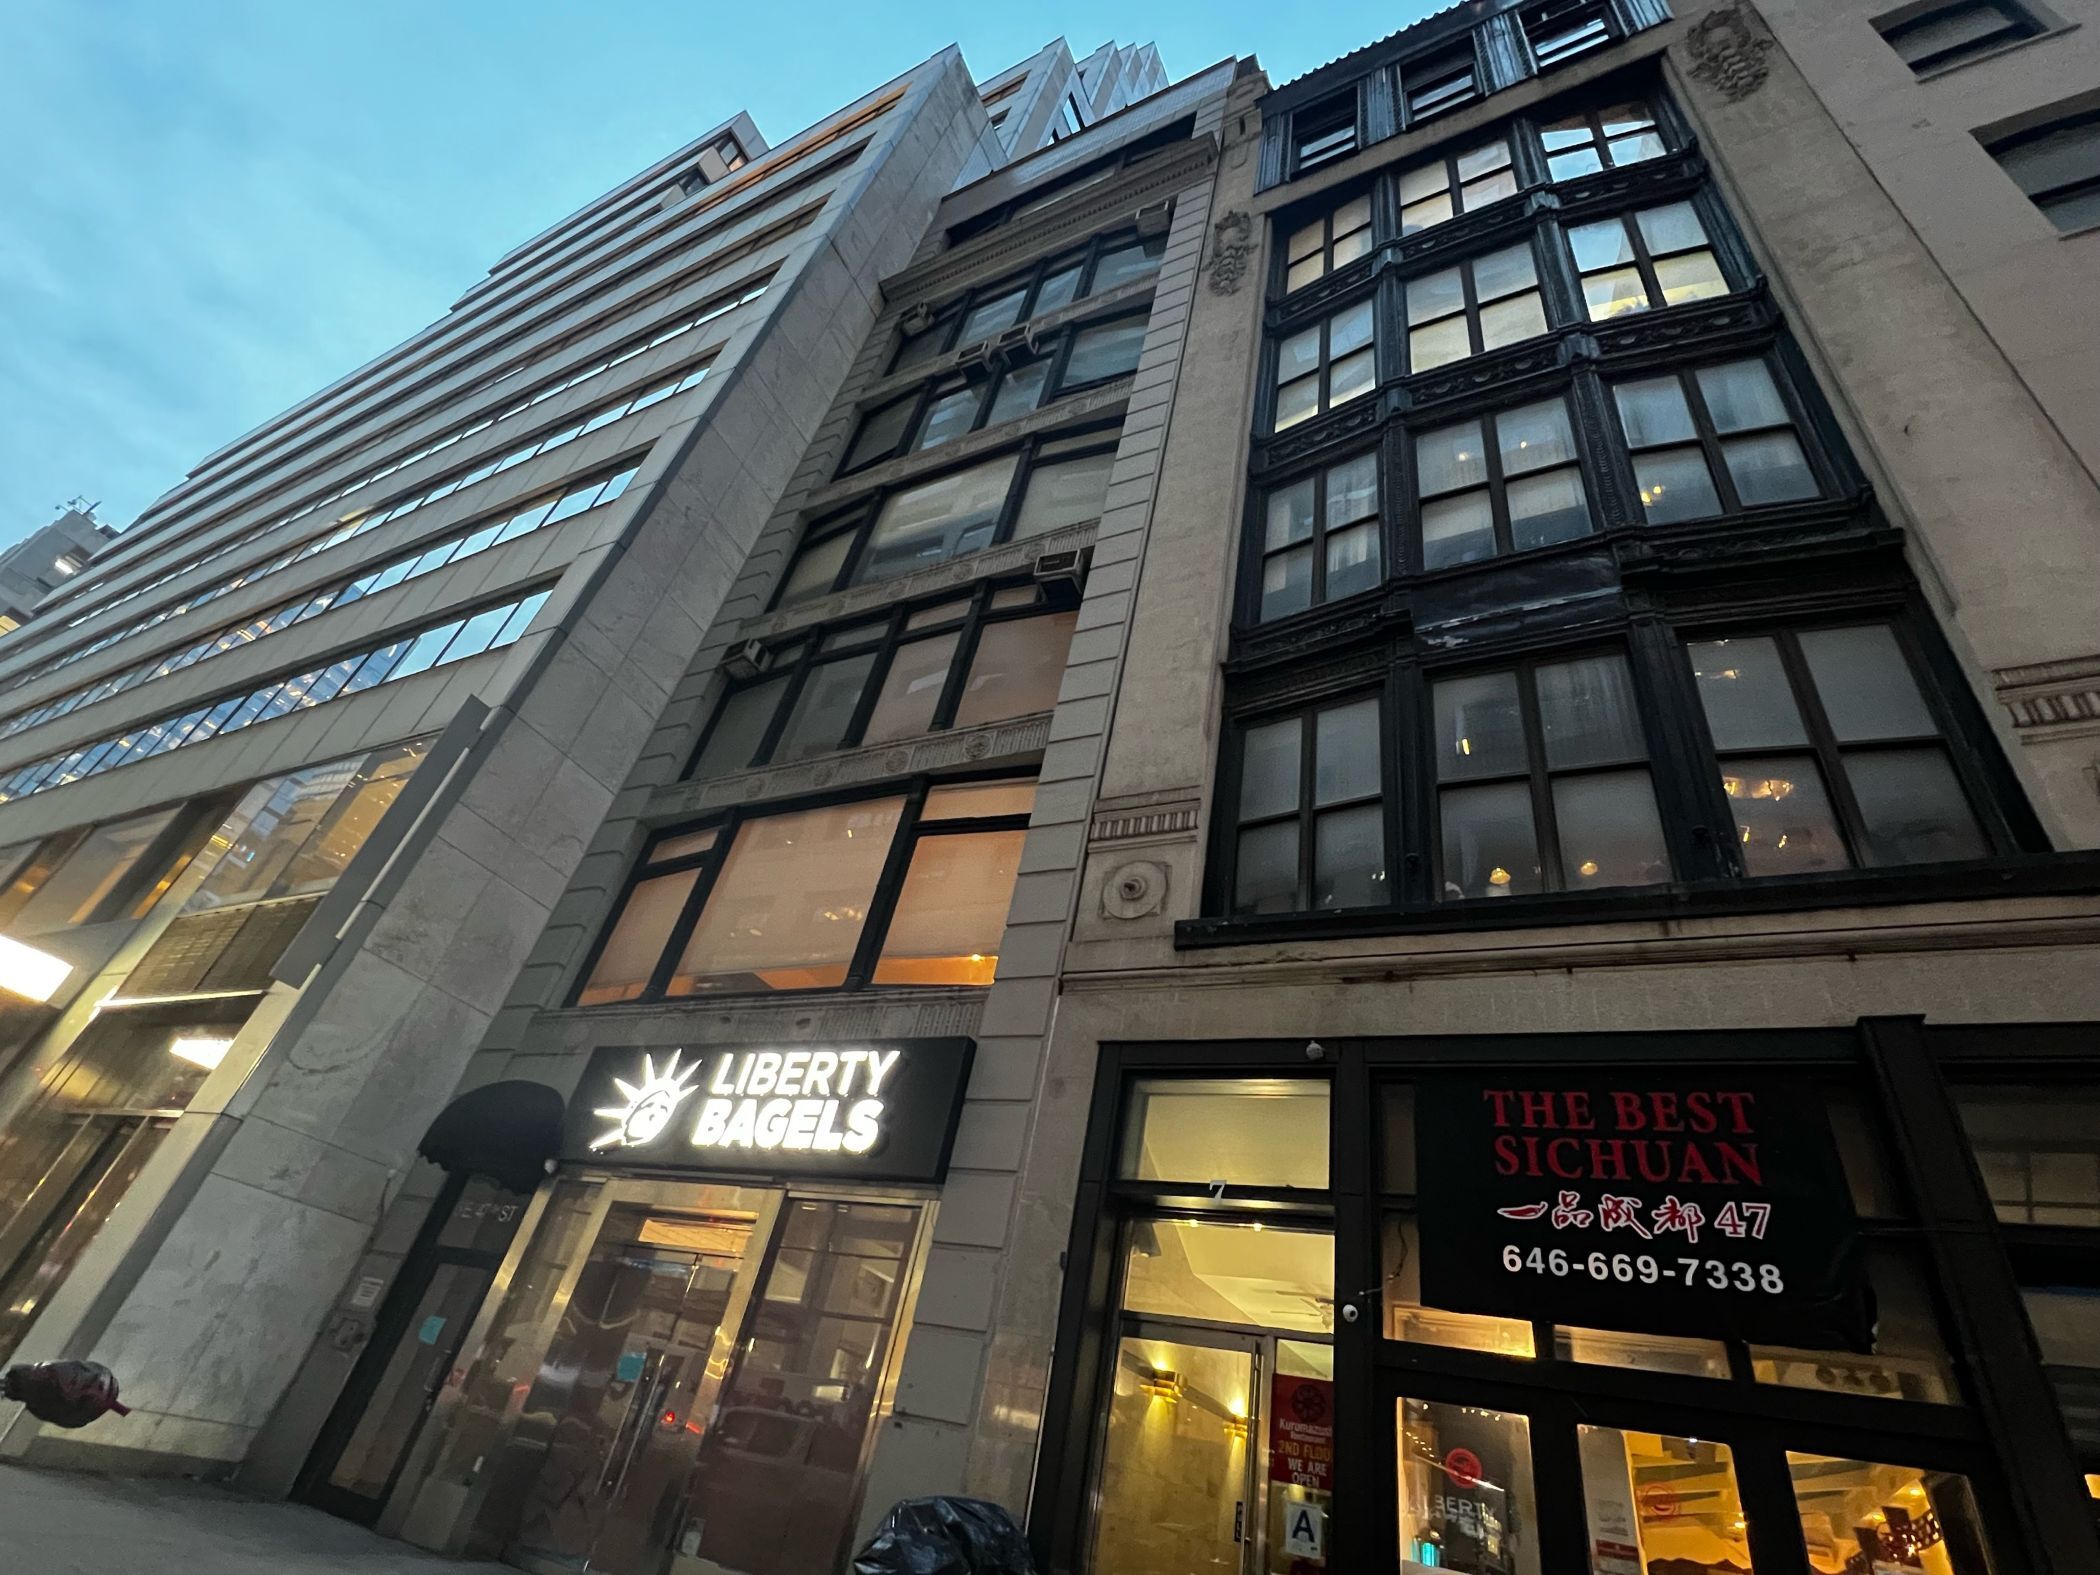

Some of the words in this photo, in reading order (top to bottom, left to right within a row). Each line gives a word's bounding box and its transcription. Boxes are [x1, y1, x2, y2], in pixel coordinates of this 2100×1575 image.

[709, 1048, 900, 1096] LIBERTY
[691, 1098, 885, 1153] BAGELS
[1483, 1089, 1596, 1129] THE
[1609, 1091, 1755, 1134] BEST
[1494, 1136, 1763, 1186] SICHUAN
[1209, 1180, 1227, 1201] 7
[1713, 1202, 1771, 1240] 47
[1502, 1245, 1785, 1294] 646-669-7338
[1288, 1457, 1303, 1472] WE
[1307, 1460, 1328, 1477] ARE
[1291, 1471, 1320, 1488] OPEN
[1291, 1509, 1315, 1543] A
